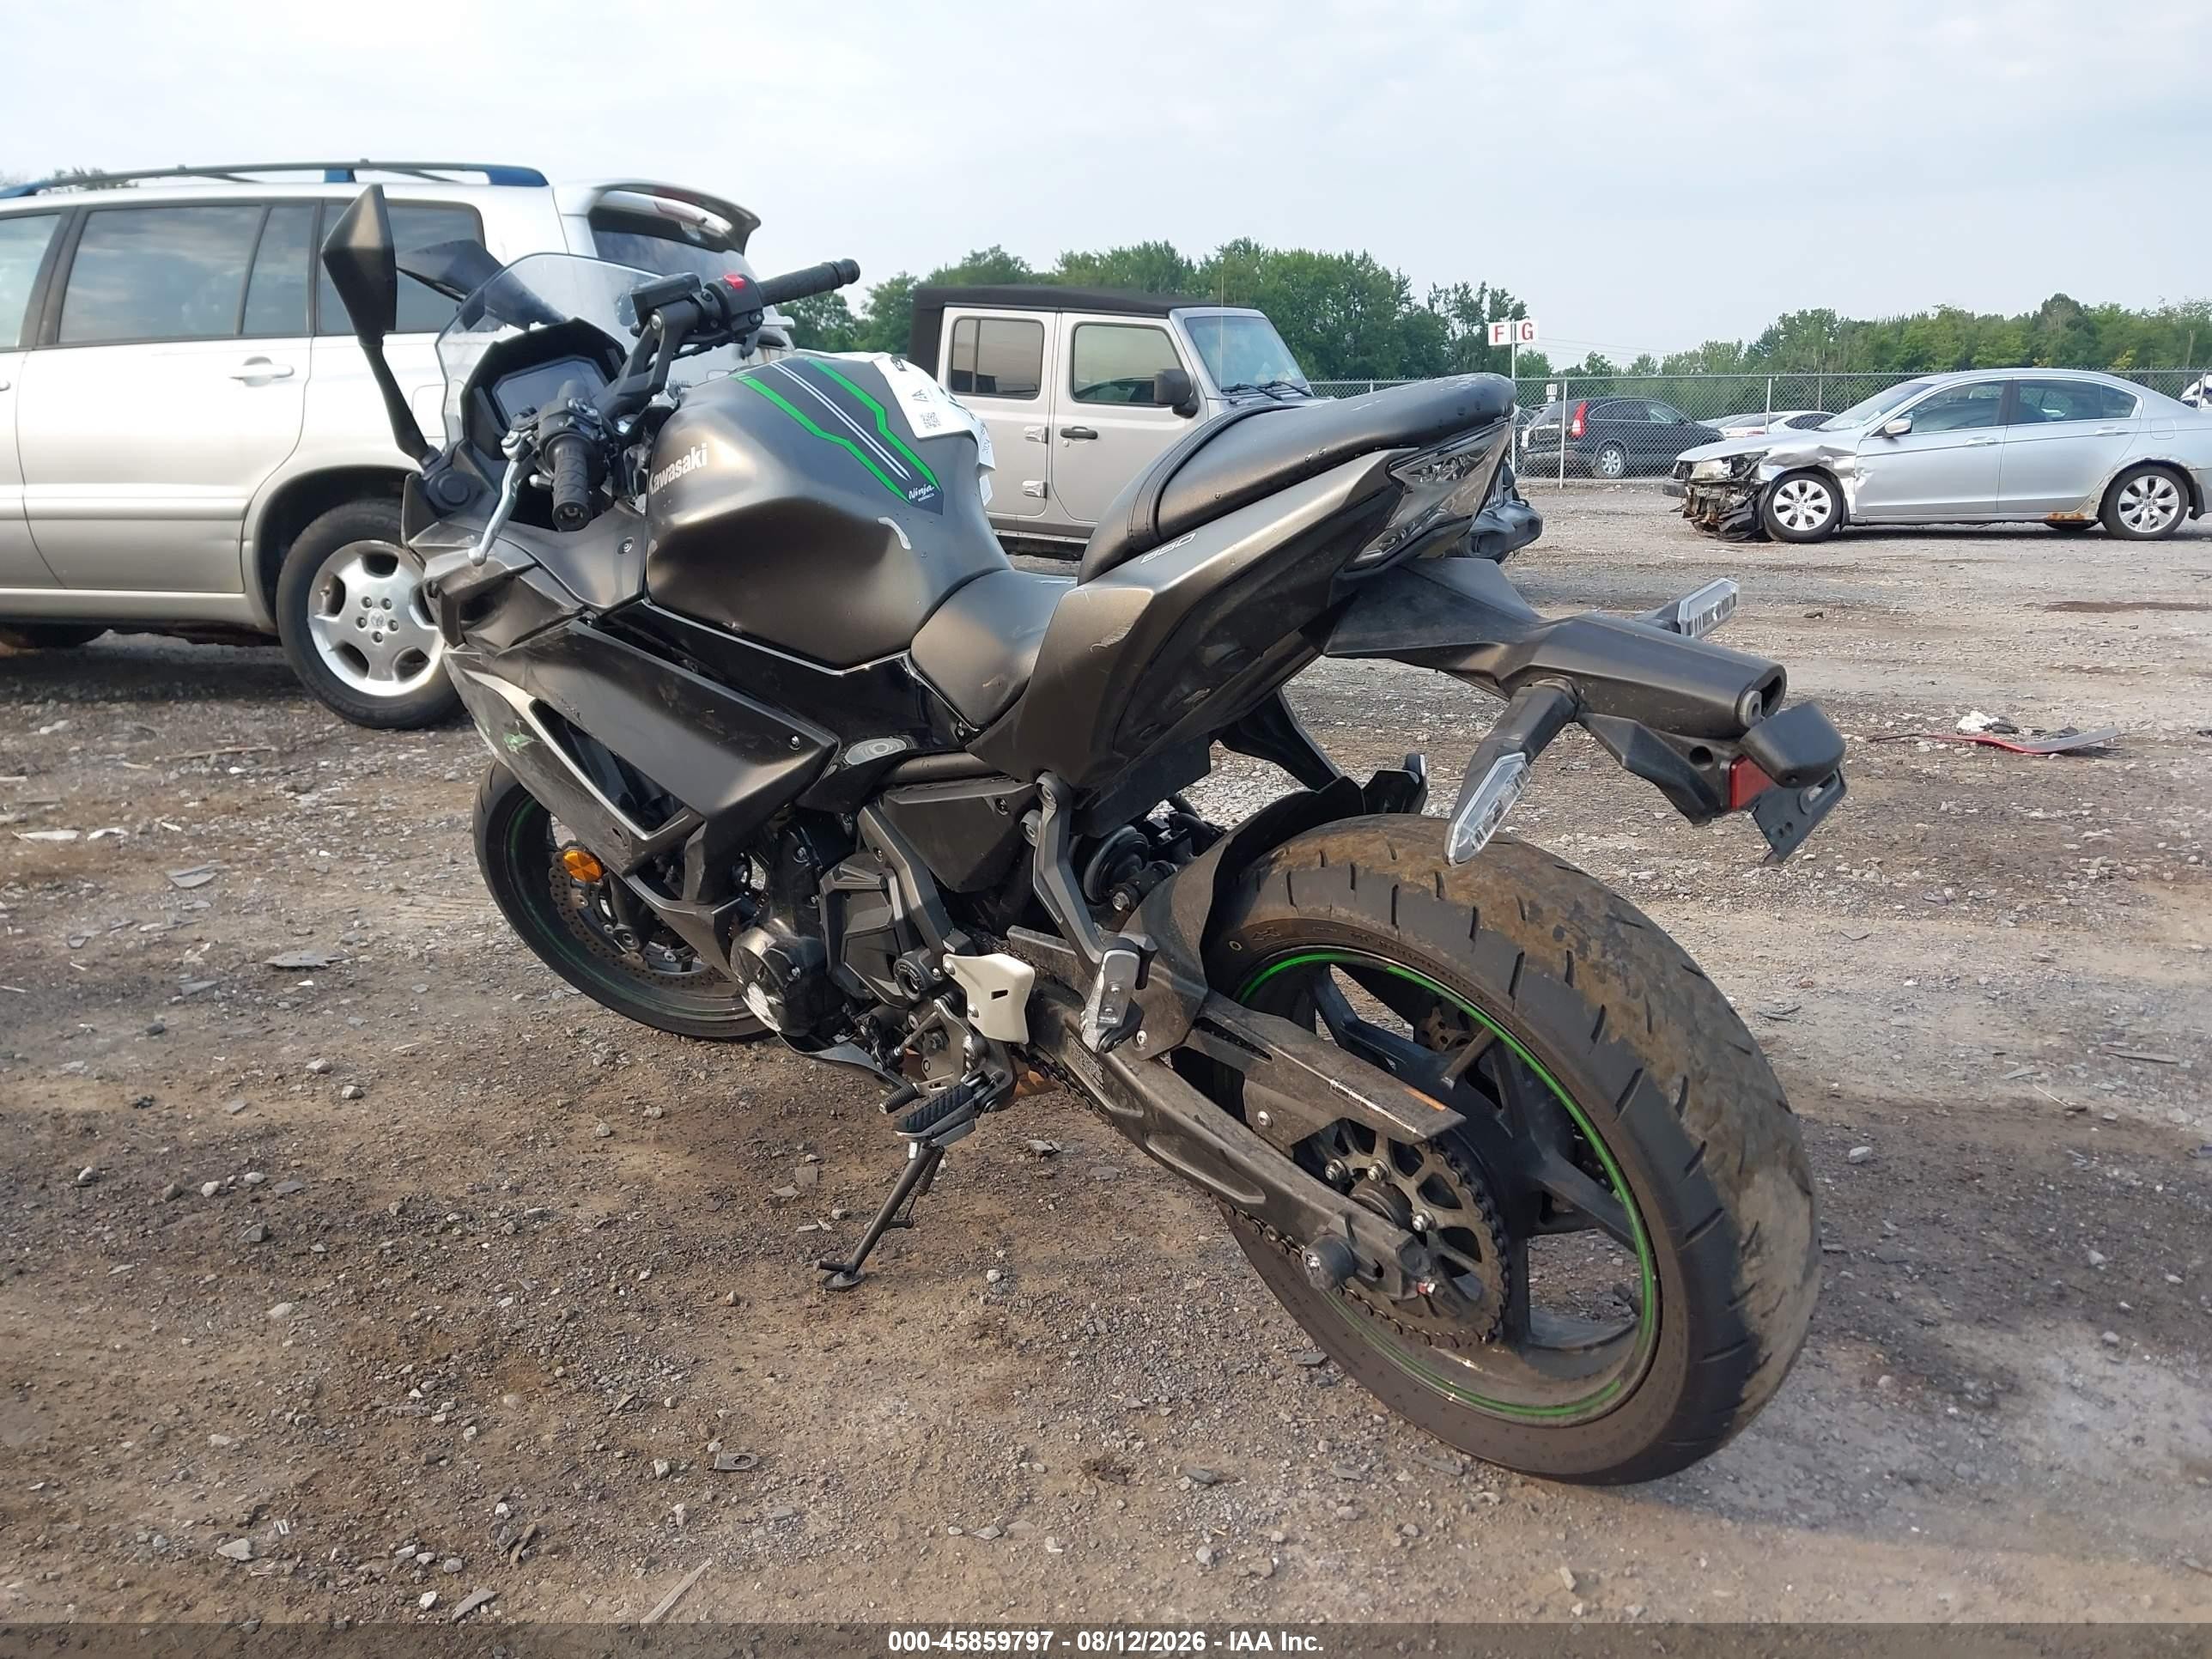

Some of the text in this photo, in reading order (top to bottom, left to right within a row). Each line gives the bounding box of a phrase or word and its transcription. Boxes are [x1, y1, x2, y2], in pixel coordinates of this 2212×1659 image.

[1494, 325, 1504, 343] F
[1522, 322, 1534, 340] G
[648, 442, 708, 497] Kawasaki
[908, 483, 935, 501] Ninja
